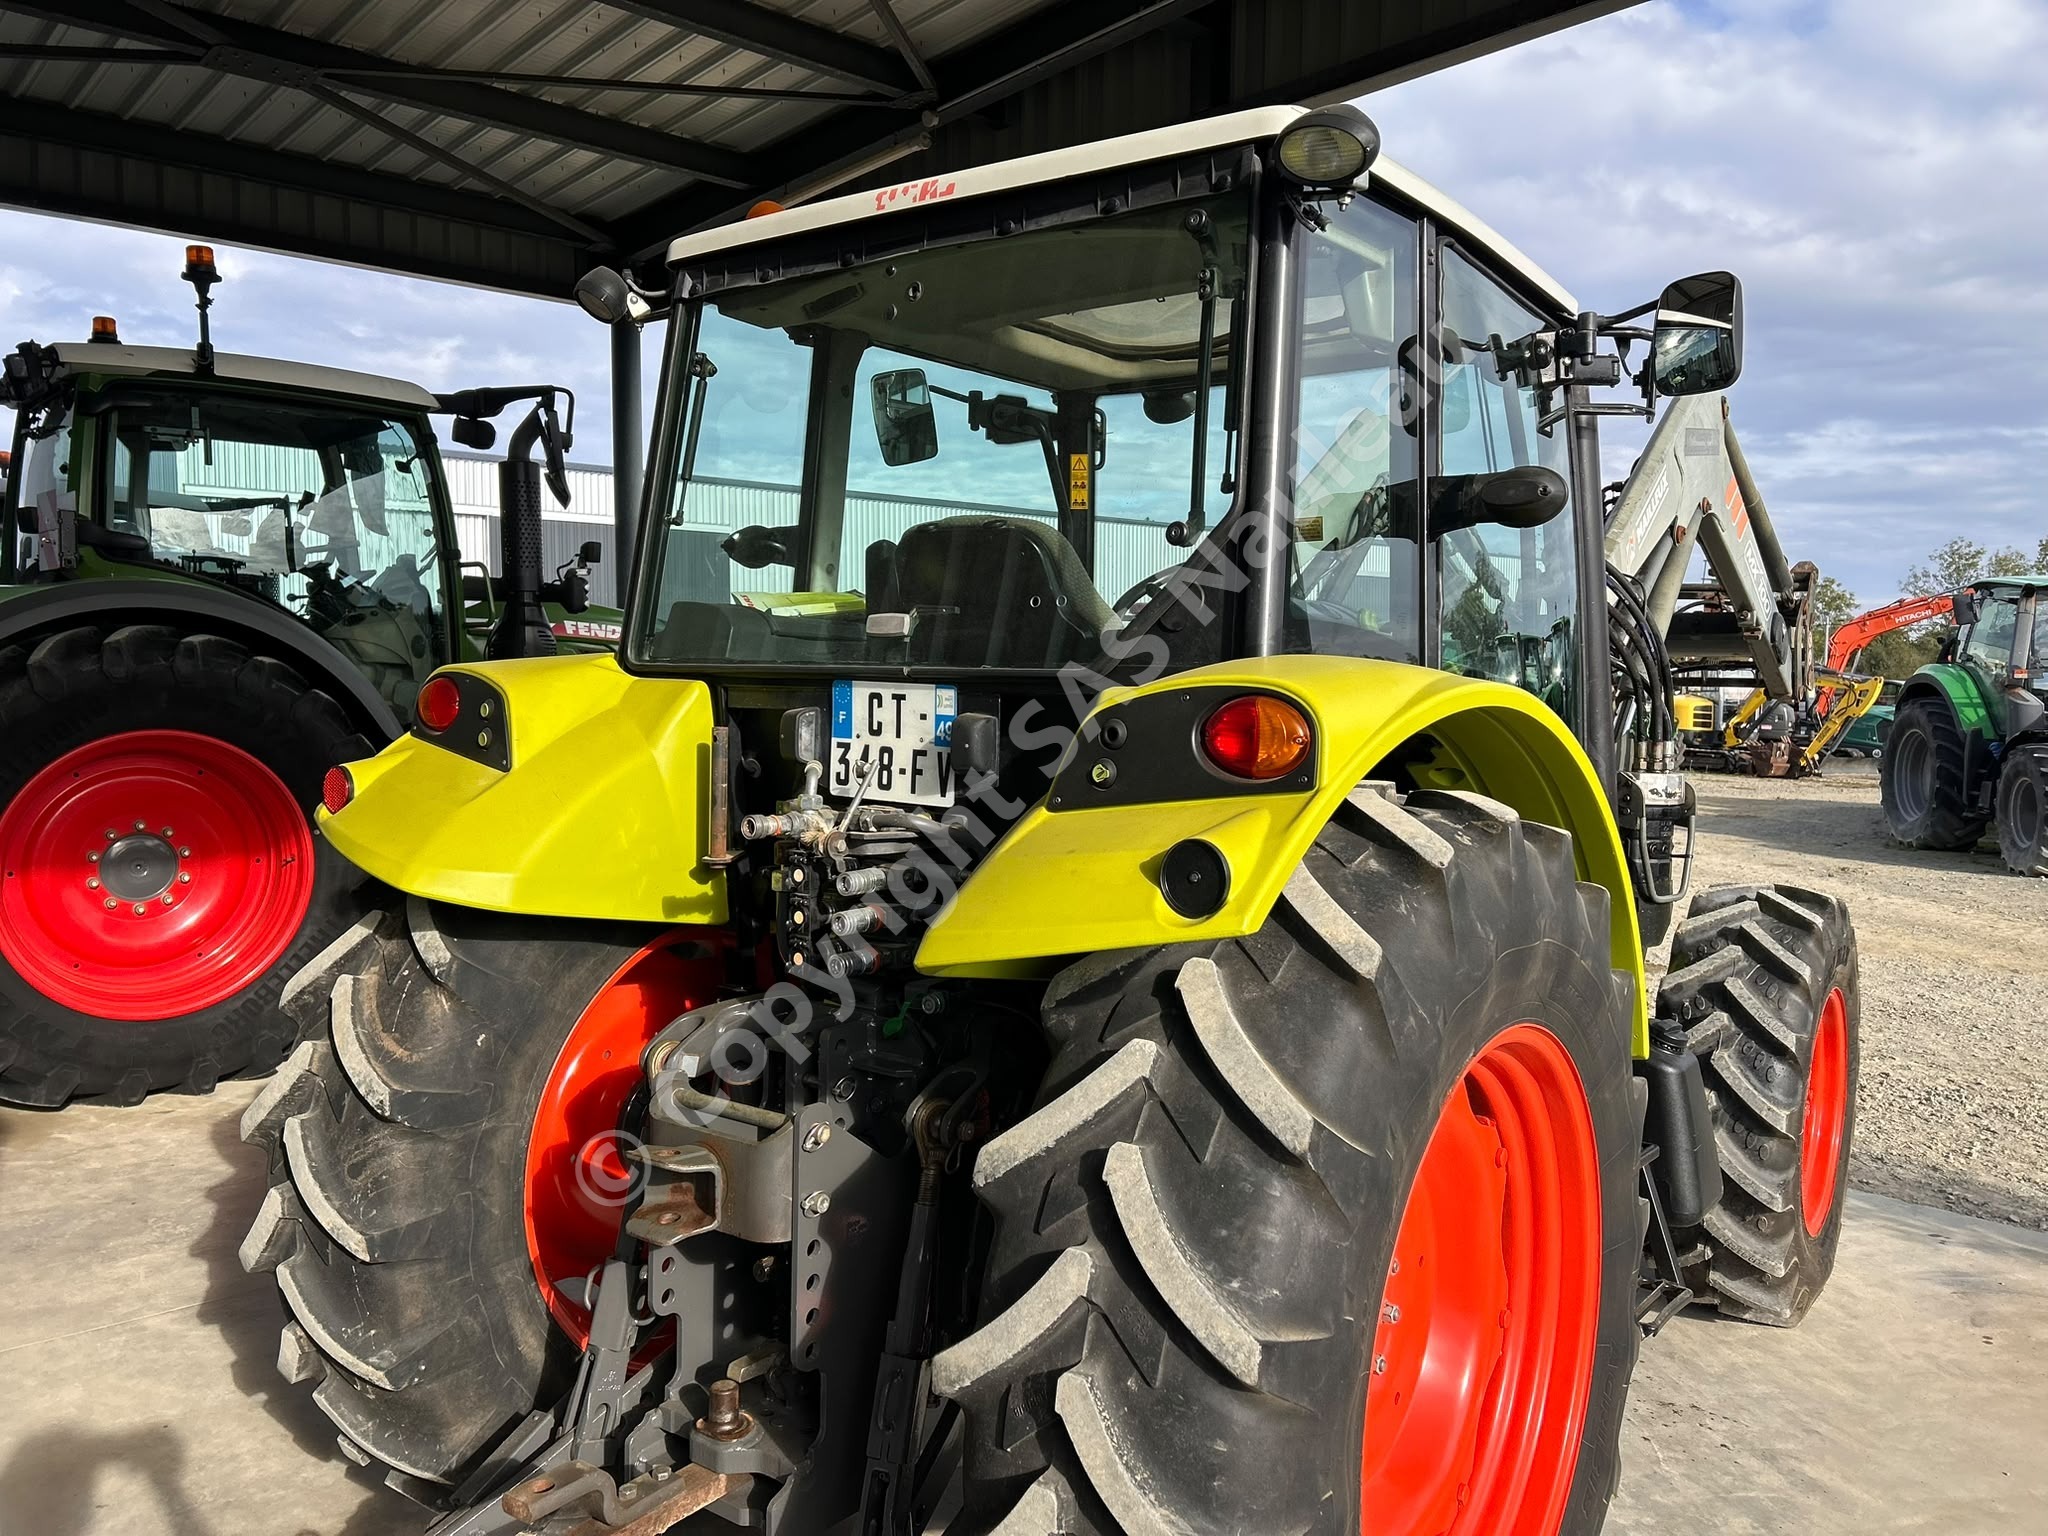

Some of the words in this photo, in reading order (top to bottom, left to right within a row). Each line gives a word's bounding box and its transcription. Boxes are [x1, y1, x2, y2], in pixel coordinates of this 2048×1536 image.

[1746, 547, 1764, 581] MX
[1757, 578, 1771, 614] 100
[1895, 610, 1932, 624] HITACHI
[563, 620, 622, 639] FEND
[839, 711, 847, 724] F
[936, 720, 952, 741] 49
